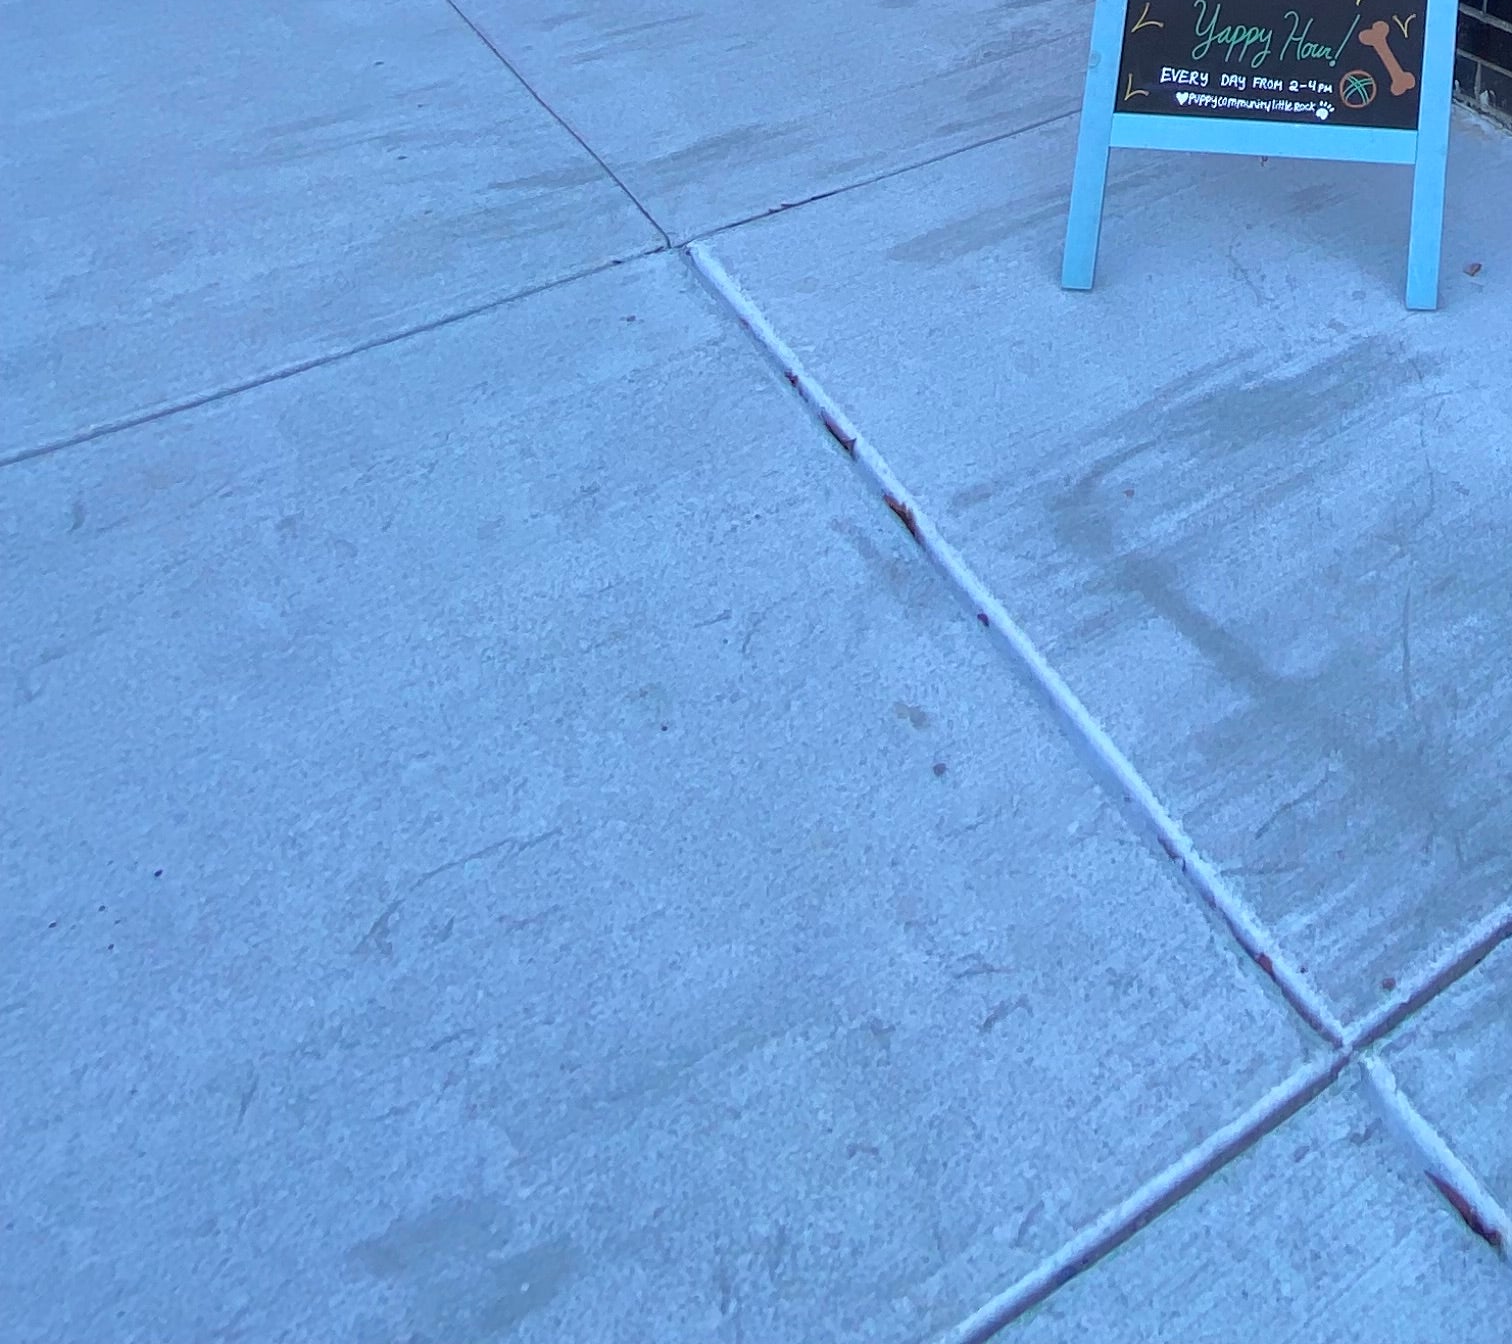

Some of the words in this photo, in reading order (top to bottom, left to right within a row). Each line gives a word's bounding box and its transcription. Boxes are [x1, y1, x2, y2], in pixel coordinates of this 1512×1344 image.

[1279, 10, 1361, 68] Hour!
[1159, 66, 1210, 87] EVERY
[1220, 73, 1247, 91] DAY
[1252, 76, 1284, 92] FROM
